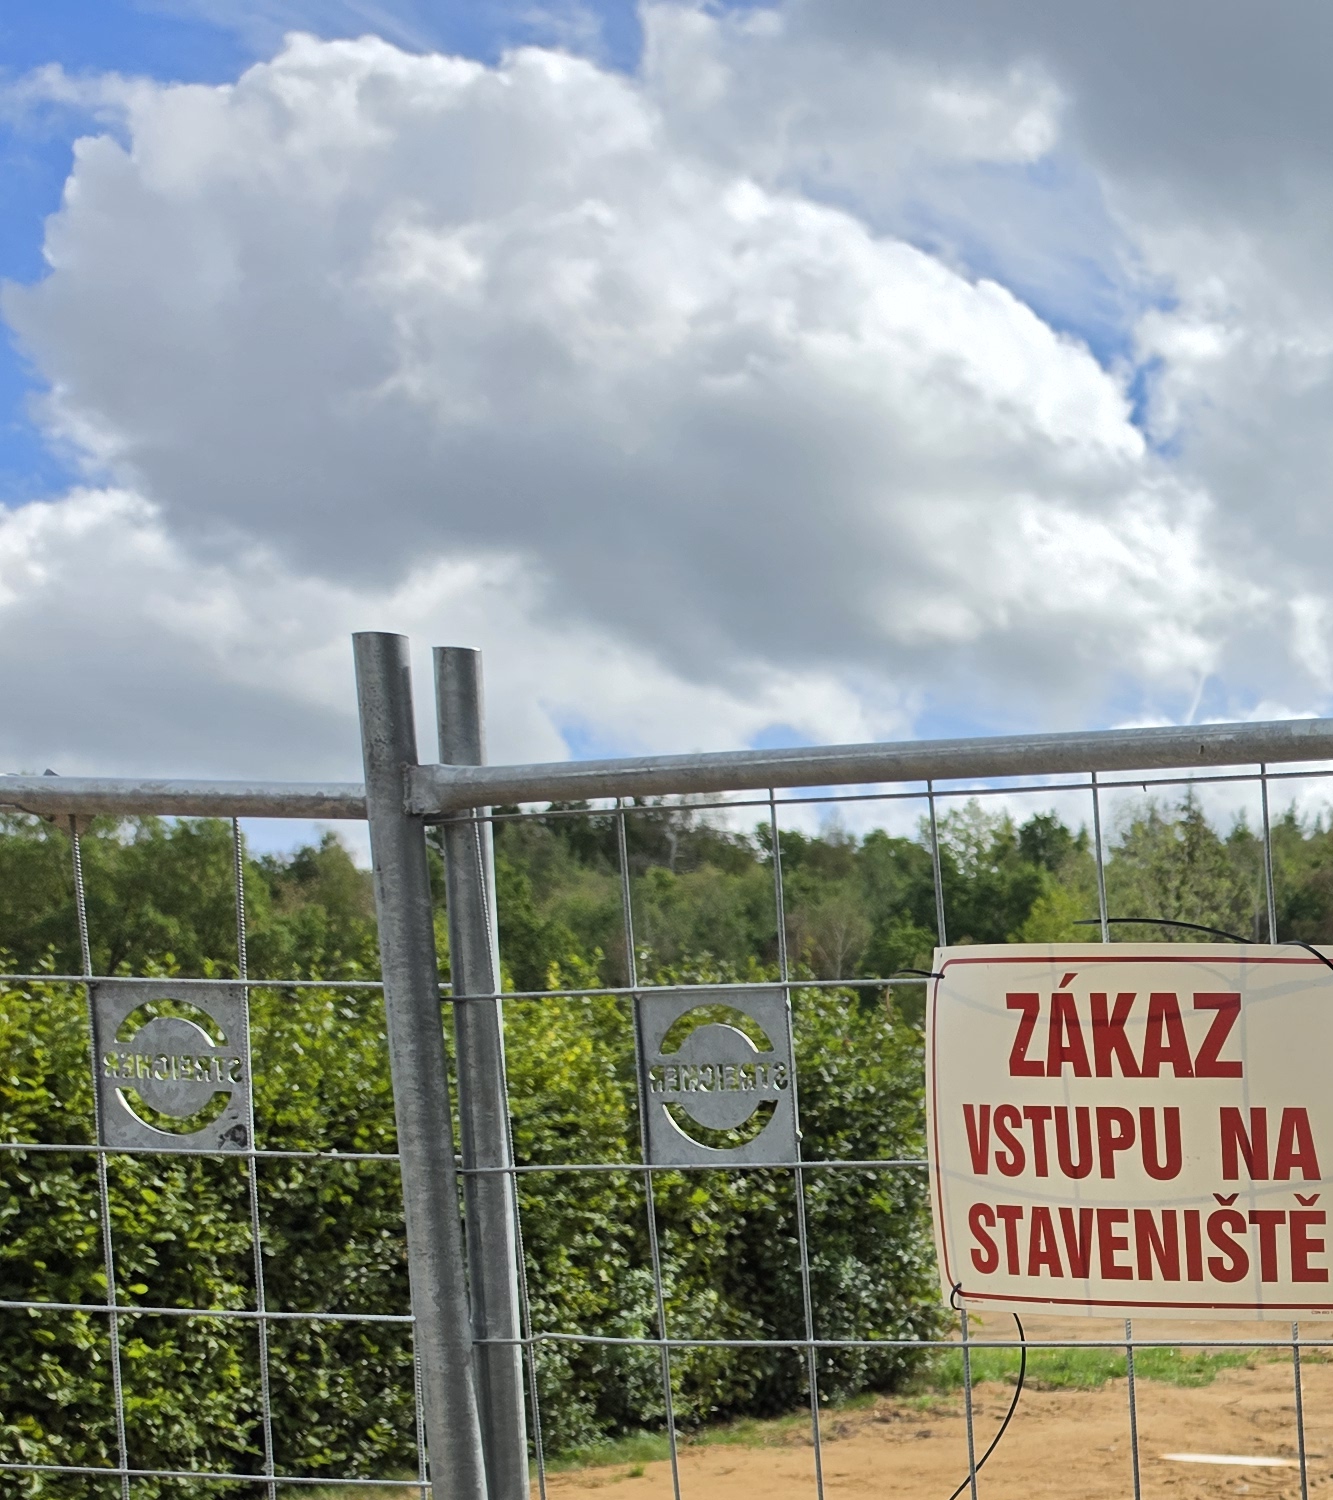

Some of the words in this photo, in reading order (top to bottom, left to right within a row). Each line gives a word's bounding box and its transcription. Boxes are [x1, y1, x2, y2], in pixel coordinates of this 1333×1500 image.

[1004, 972, 1244, 1079] ZÁKAZ
[962, 1103, 1183, 1181] VSTUPU
[1219, 1106, 1322, 1181] NA
[967, 1192, 1330, 1284] STAVENIŠTĚ
